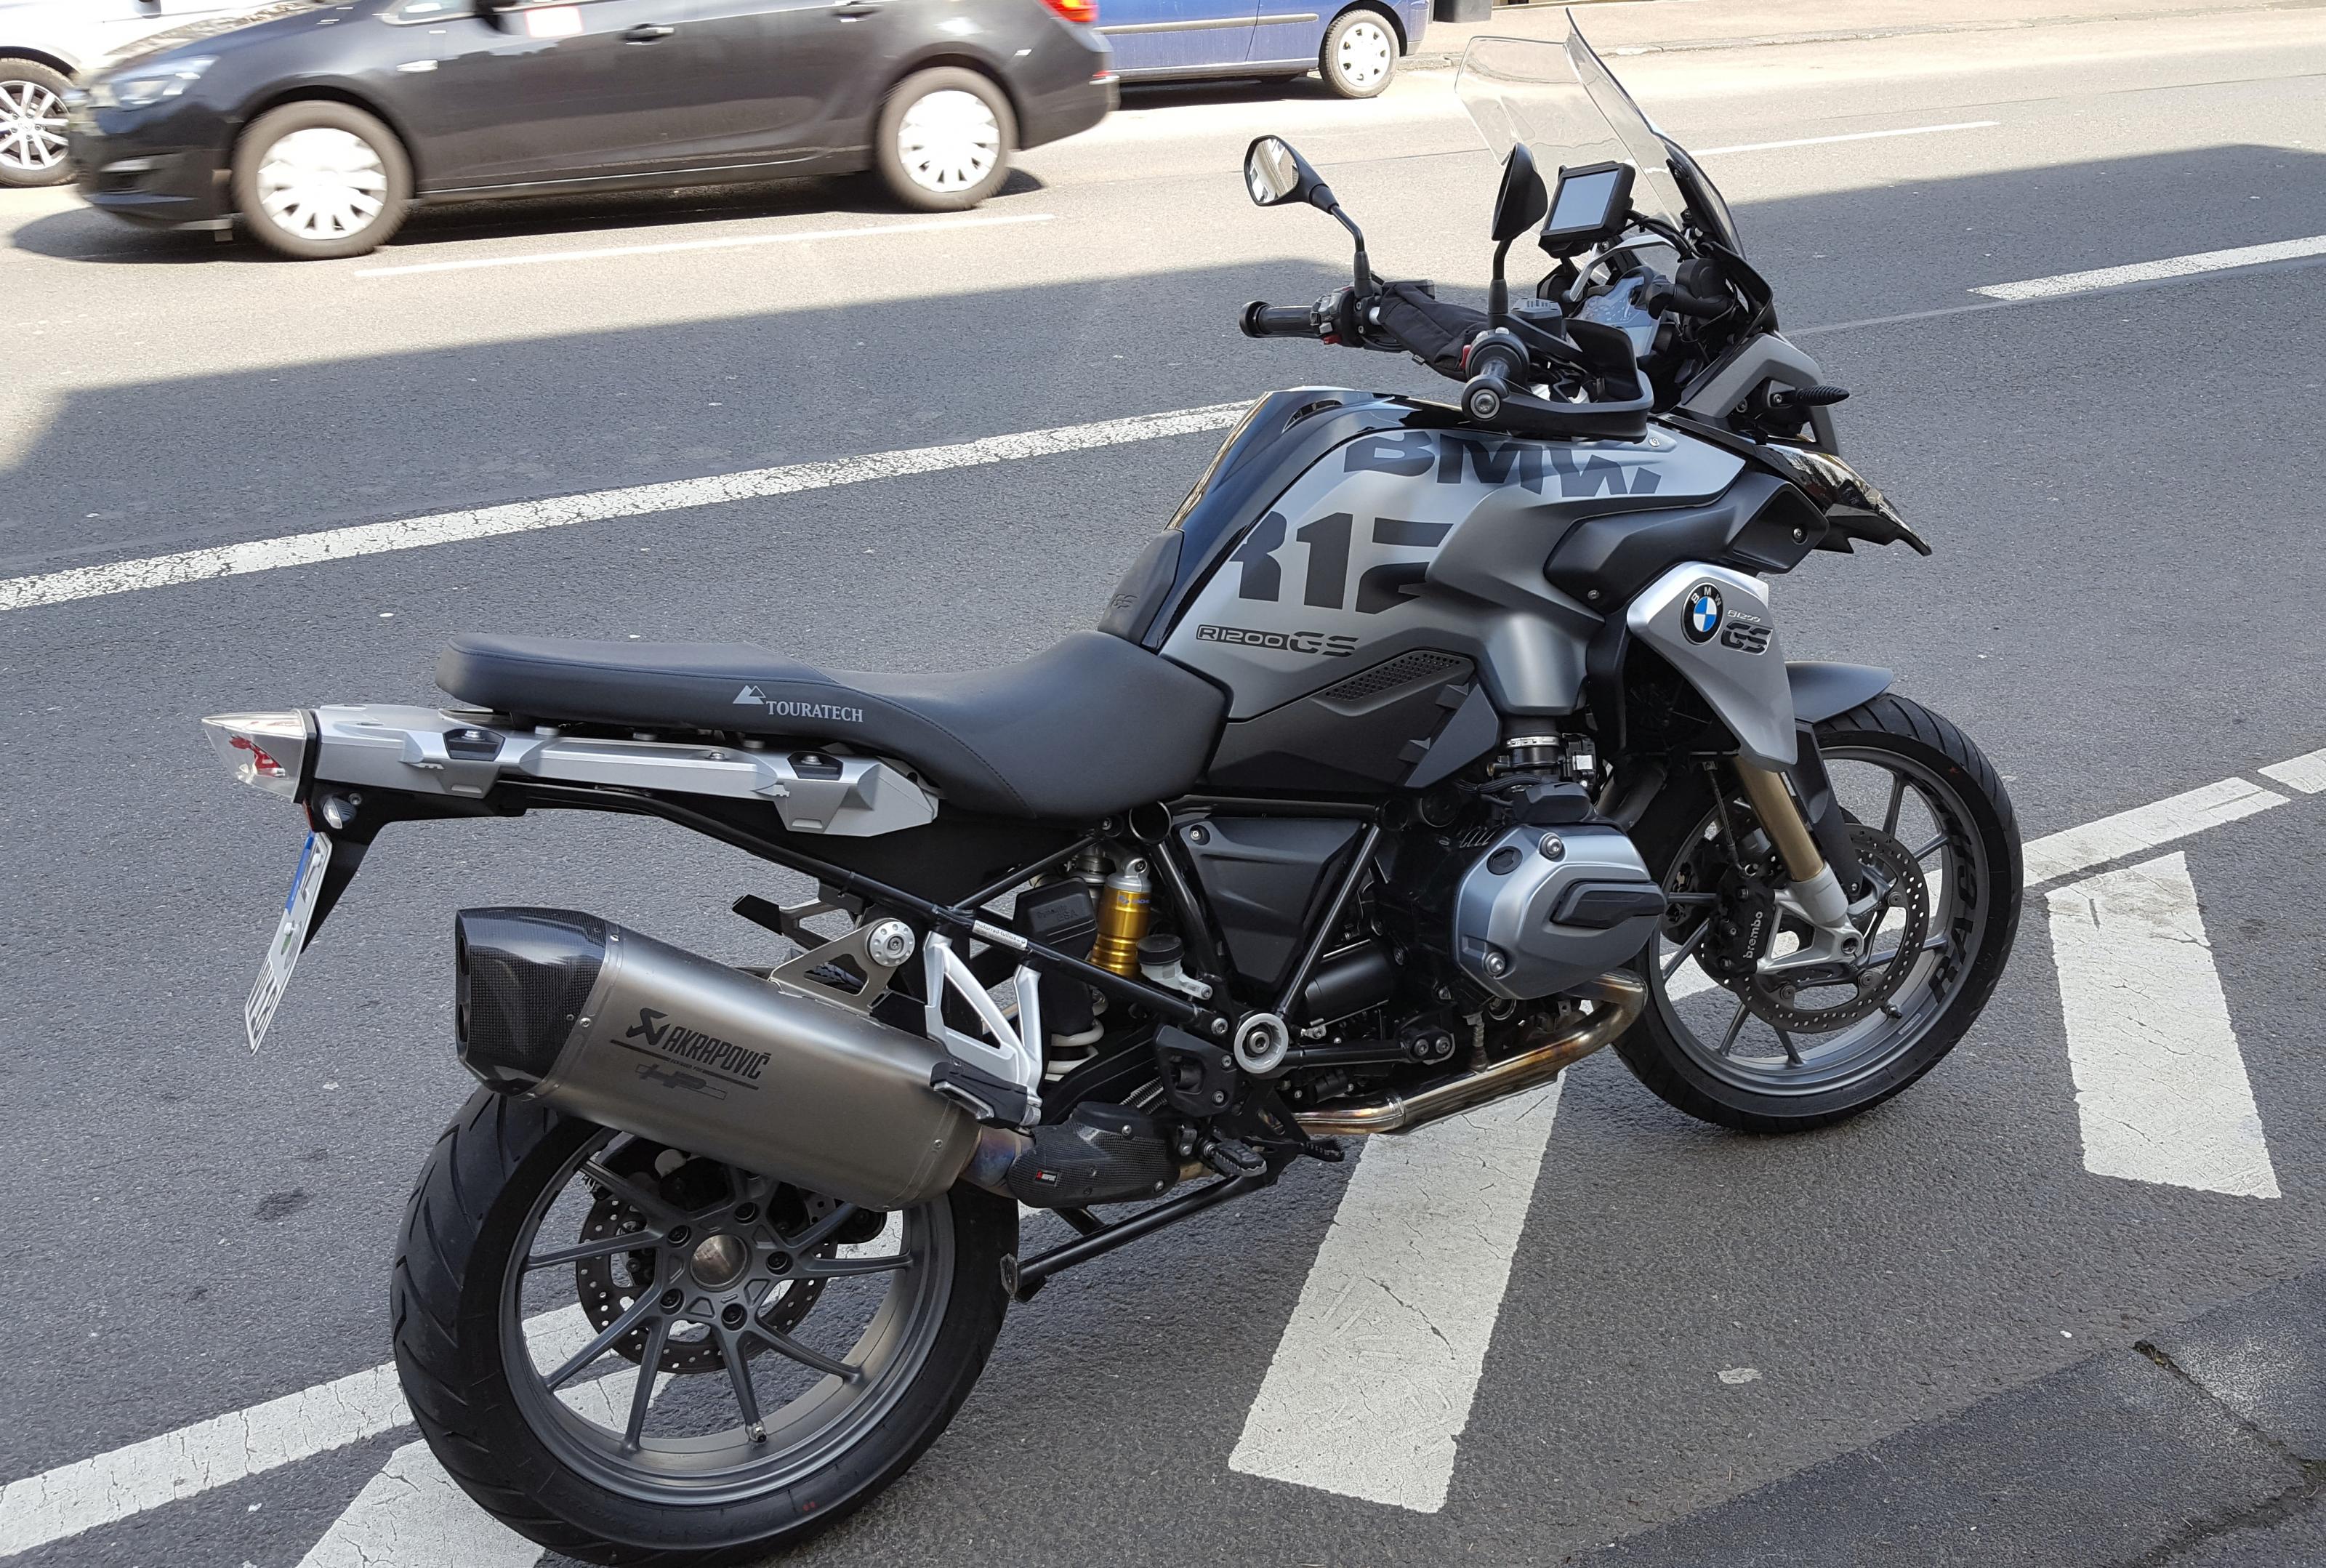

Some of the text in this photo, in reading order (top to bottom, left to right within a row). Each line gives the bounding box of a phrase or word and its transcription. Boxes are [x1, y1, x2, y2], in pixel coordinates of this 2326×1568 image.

[1343, 431, 1662, 497] BMW
[1691, 586, 1722, 606] BMW
[766, 701, 864, 723] TOURATECH
[1742, 911, 1763, 959] brembo
